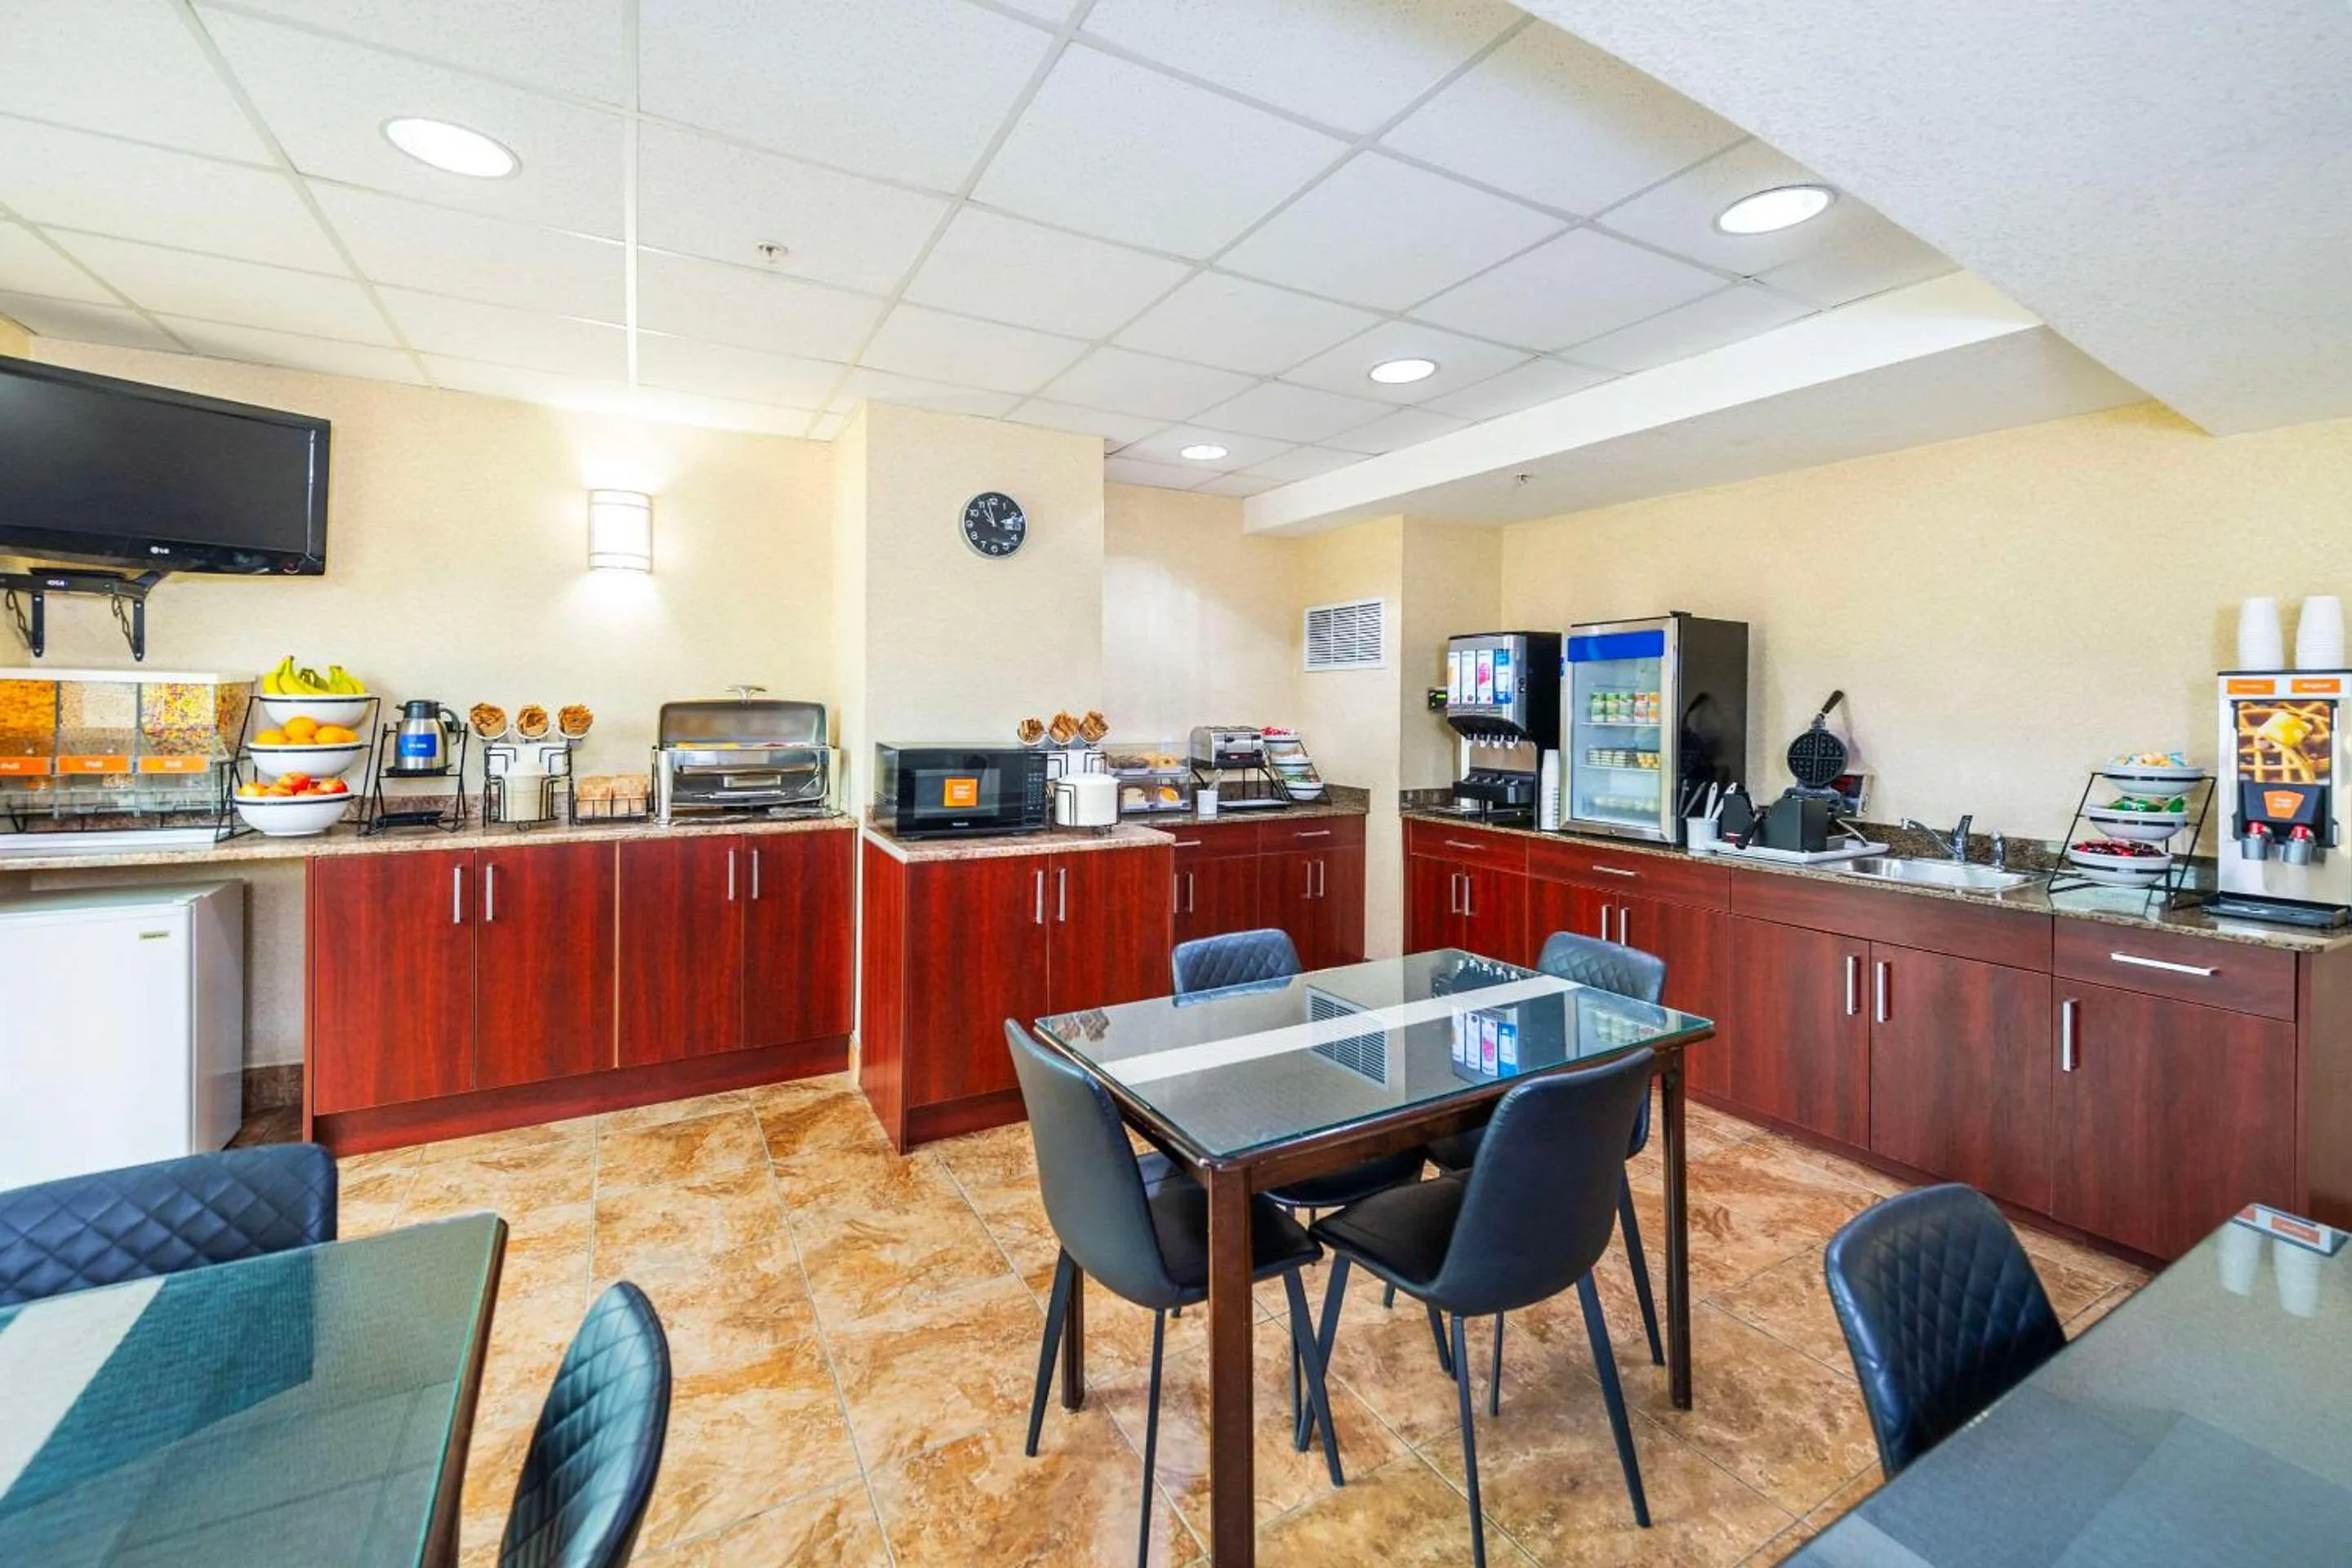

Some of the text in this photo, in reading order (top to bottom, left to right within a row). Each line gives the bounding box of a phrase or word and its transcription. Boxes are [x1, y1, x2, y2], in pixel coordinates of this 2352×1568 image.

[978, 501, 986, 509] 11
[989, 497, 998, 506] 12
[969, 509, 979, 518] 10
[965, 519, 973, 528] 9
[970, 531, 978, 540] 8
[1010, 533, 1018, 542] 4
[980, 540, 987, 550] 7
[990, 544, 998, 553] 6
